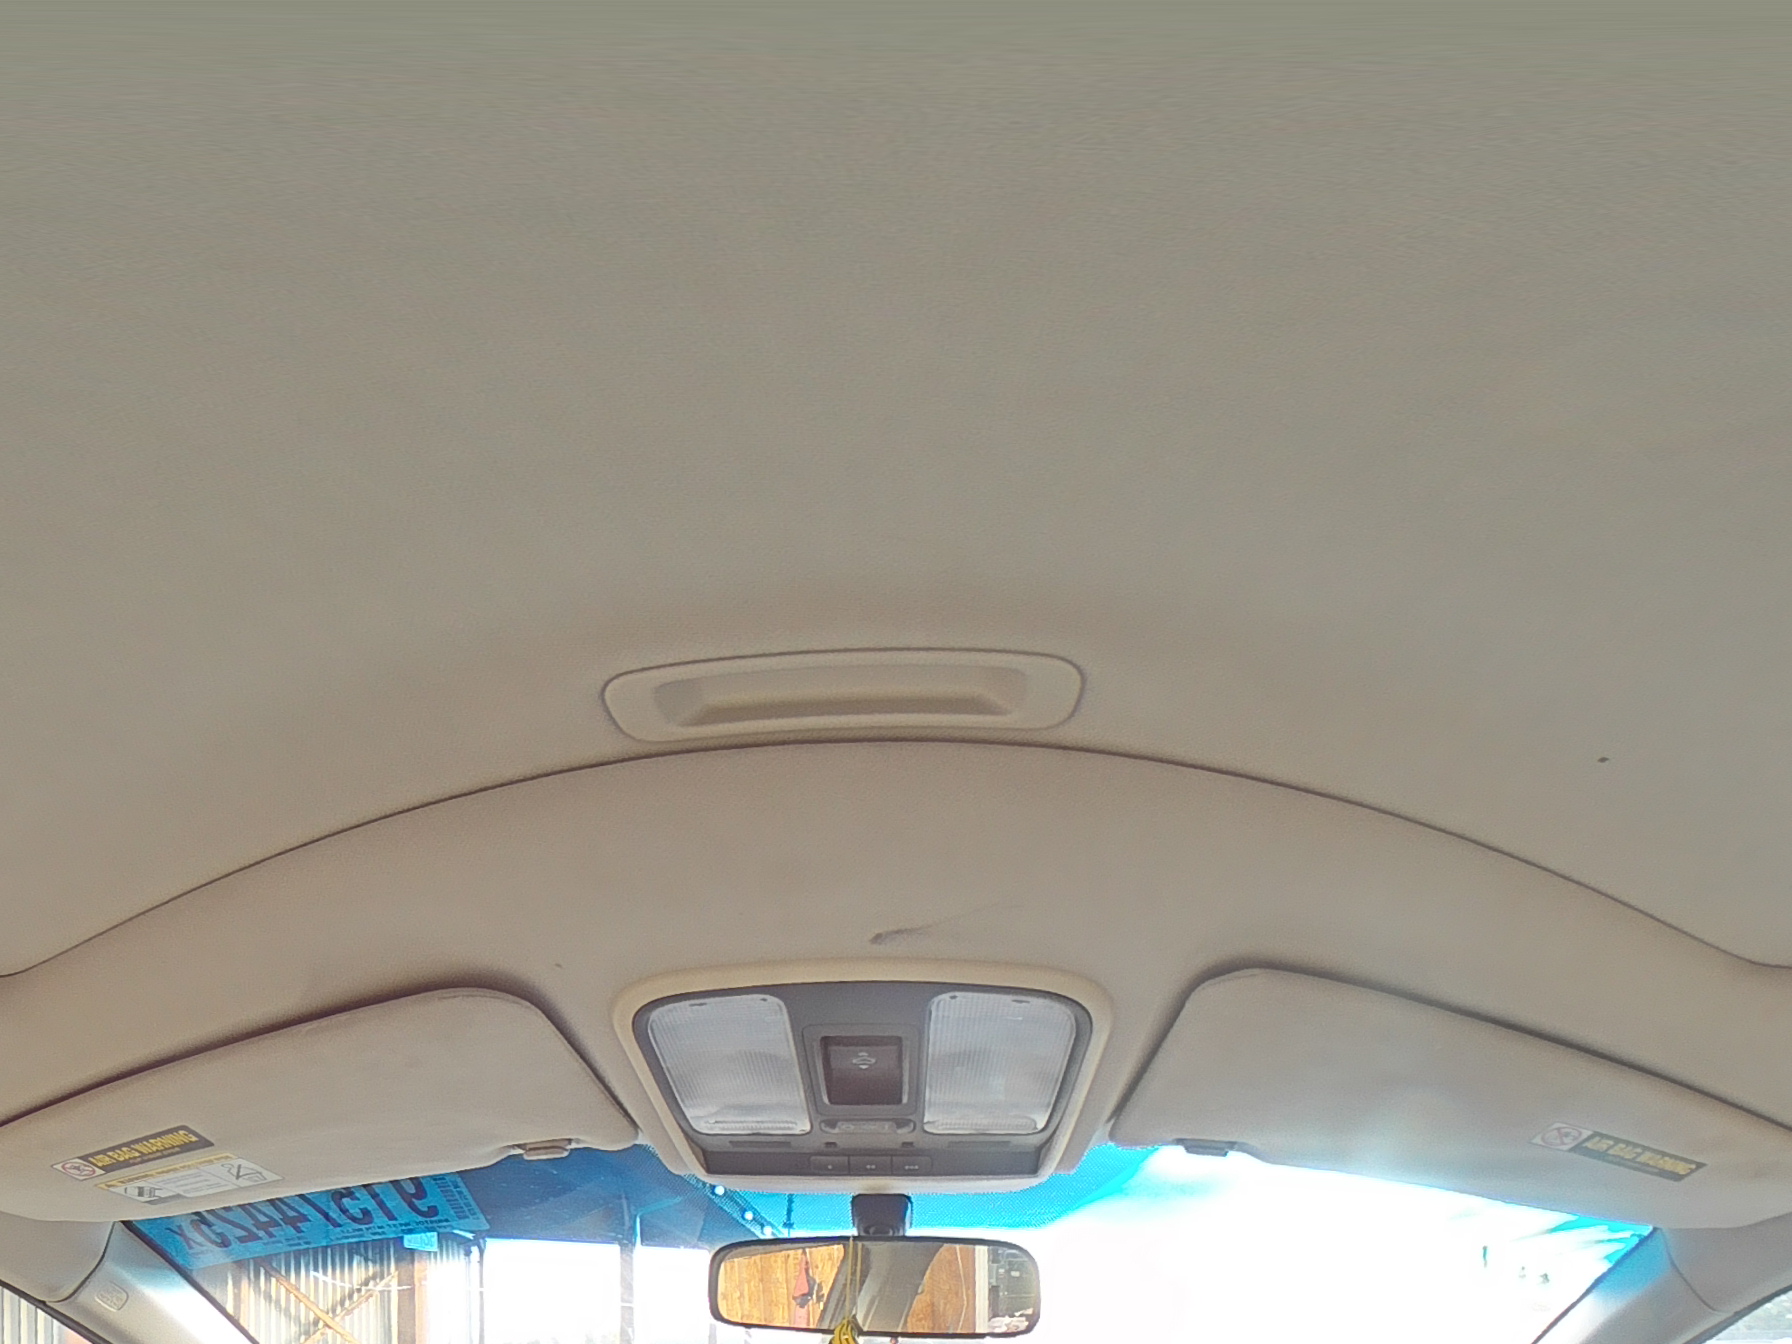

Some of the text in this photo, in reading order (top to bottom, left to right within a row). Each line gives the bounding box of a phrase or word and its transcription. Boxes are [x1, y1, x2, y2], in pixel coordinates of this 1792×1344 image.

[88, 1154, 117, 1167] AIR
[106, 1147, 142, 1161] BAG
[130, 1130, 200, 1154] WARNING
[1582, 1136, 1614, 1152] AIR
[1607, 1143, 1643, 1159] BAG
[1636, 1151, 1697, 1175] WARNING
